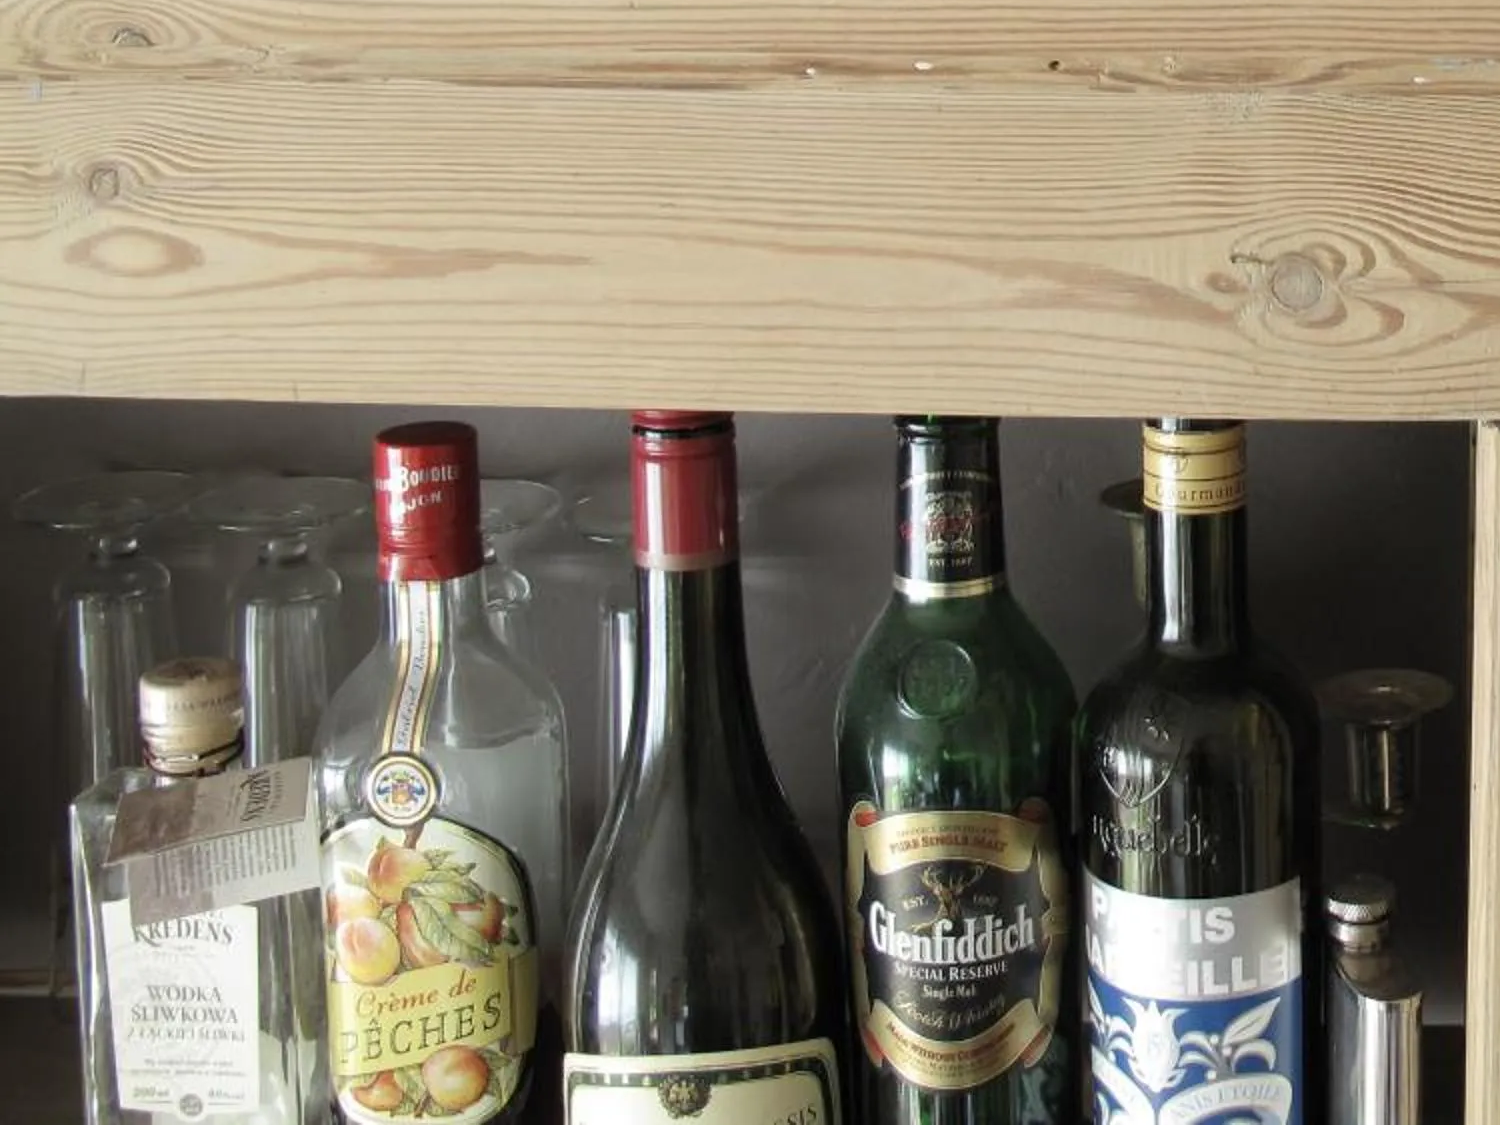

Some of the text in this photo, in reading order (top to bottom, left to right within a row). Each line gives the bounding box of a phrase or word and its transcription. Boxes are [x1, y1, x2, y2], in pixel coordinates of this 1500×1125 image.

[869, 900, 1036, 965] Glenfiddich
[1091, 881, 1236, 945] PTIS
[895, 960, 1009, 981] SPECIAL RESERVE
[1085, 923, 1289, 995] AEILLE
[355, 969, 478, 1019] Crème de
[340, 992, 502, 1064] PÊCHES
